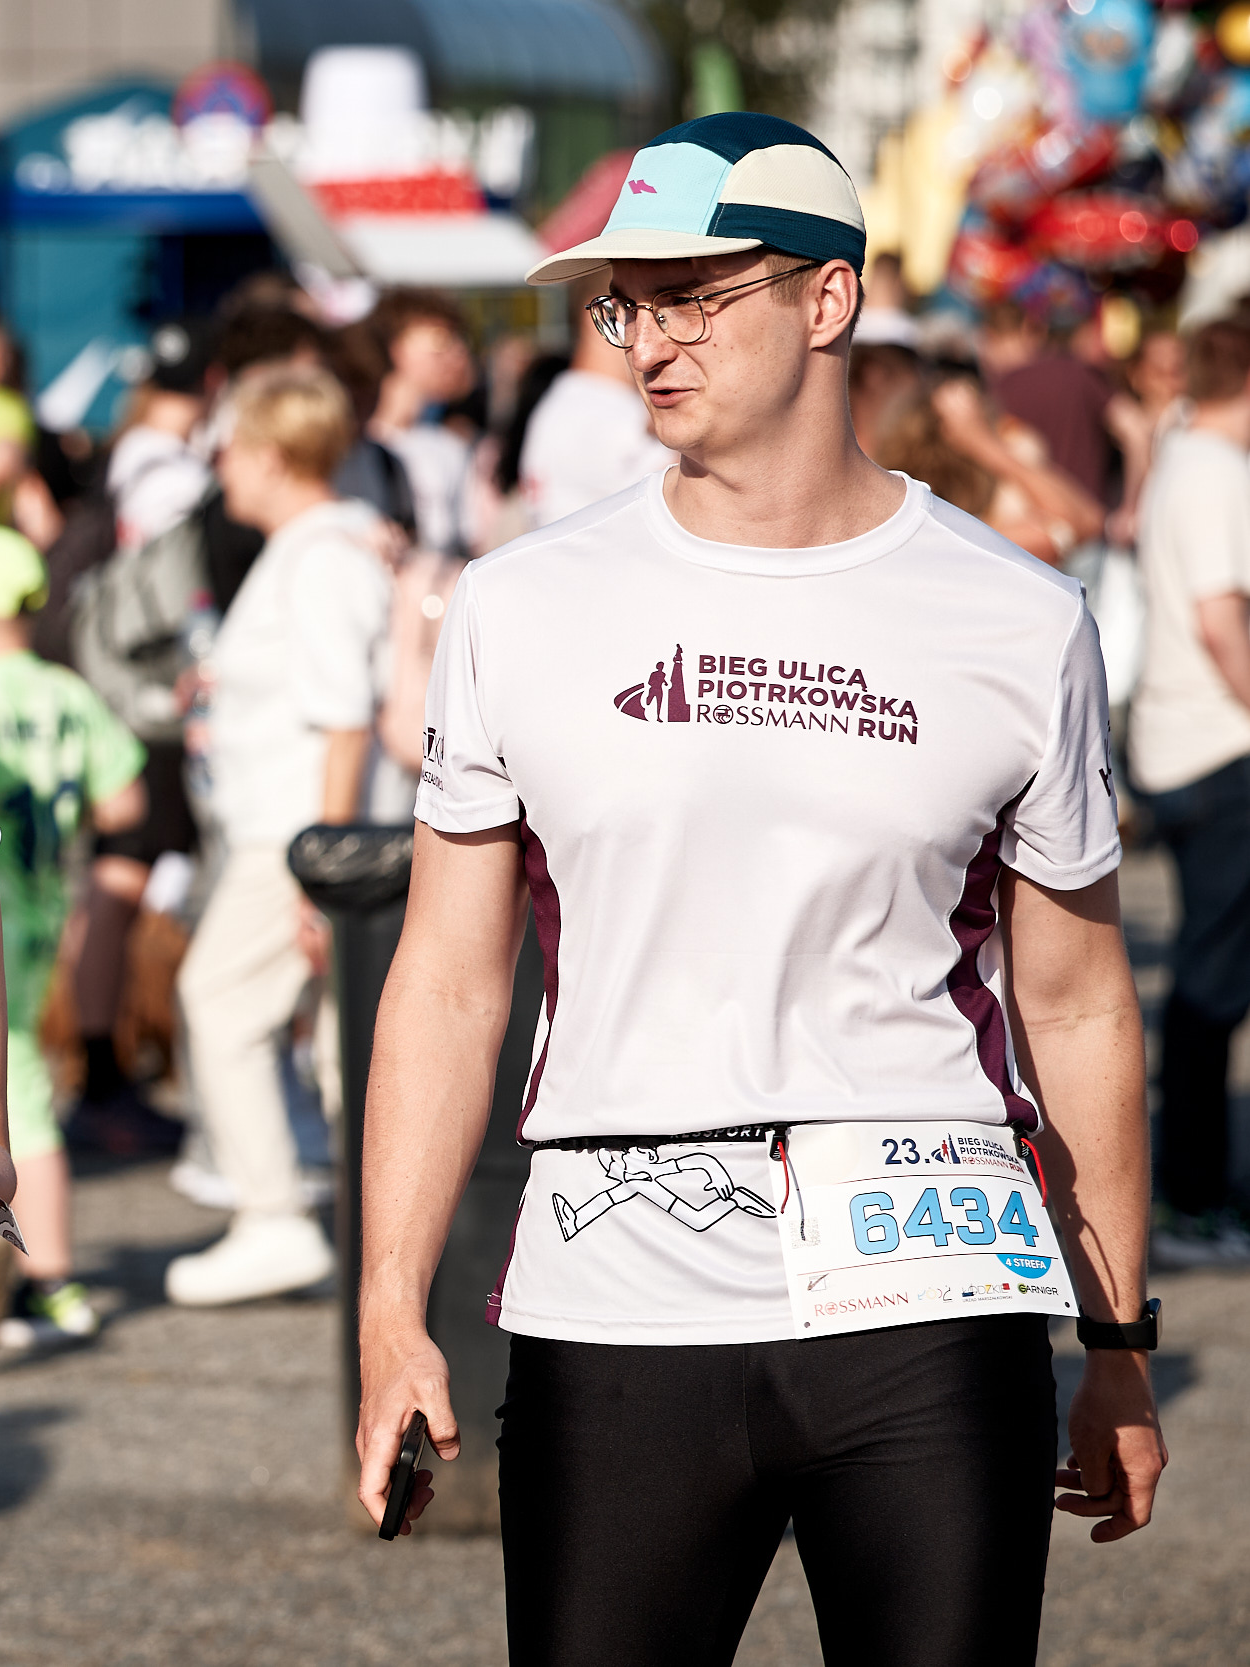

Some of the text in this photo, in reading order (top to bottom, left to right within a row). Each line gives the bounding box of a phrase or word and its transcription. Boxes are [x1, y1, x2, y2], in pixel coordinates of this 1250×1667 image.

[698, 654, 868, 692] BIEG ULICĄ
[698, 679, 918, 724] PIOTRKOWSKĄ
[696, 703, 918, 745] ROSSMANN RUN
[881, 1138, 931, 1165] 23.
[957, 1137, 980, 1146] BIEG
[961, 1156, 1009, 1169] ROSSMANN
[849, 1187, 1039, 1255] 6434
[1005, 1257, 1047, 1270] 4 STREFA
[813, 1291, 909, 1317] ROSSMANN
